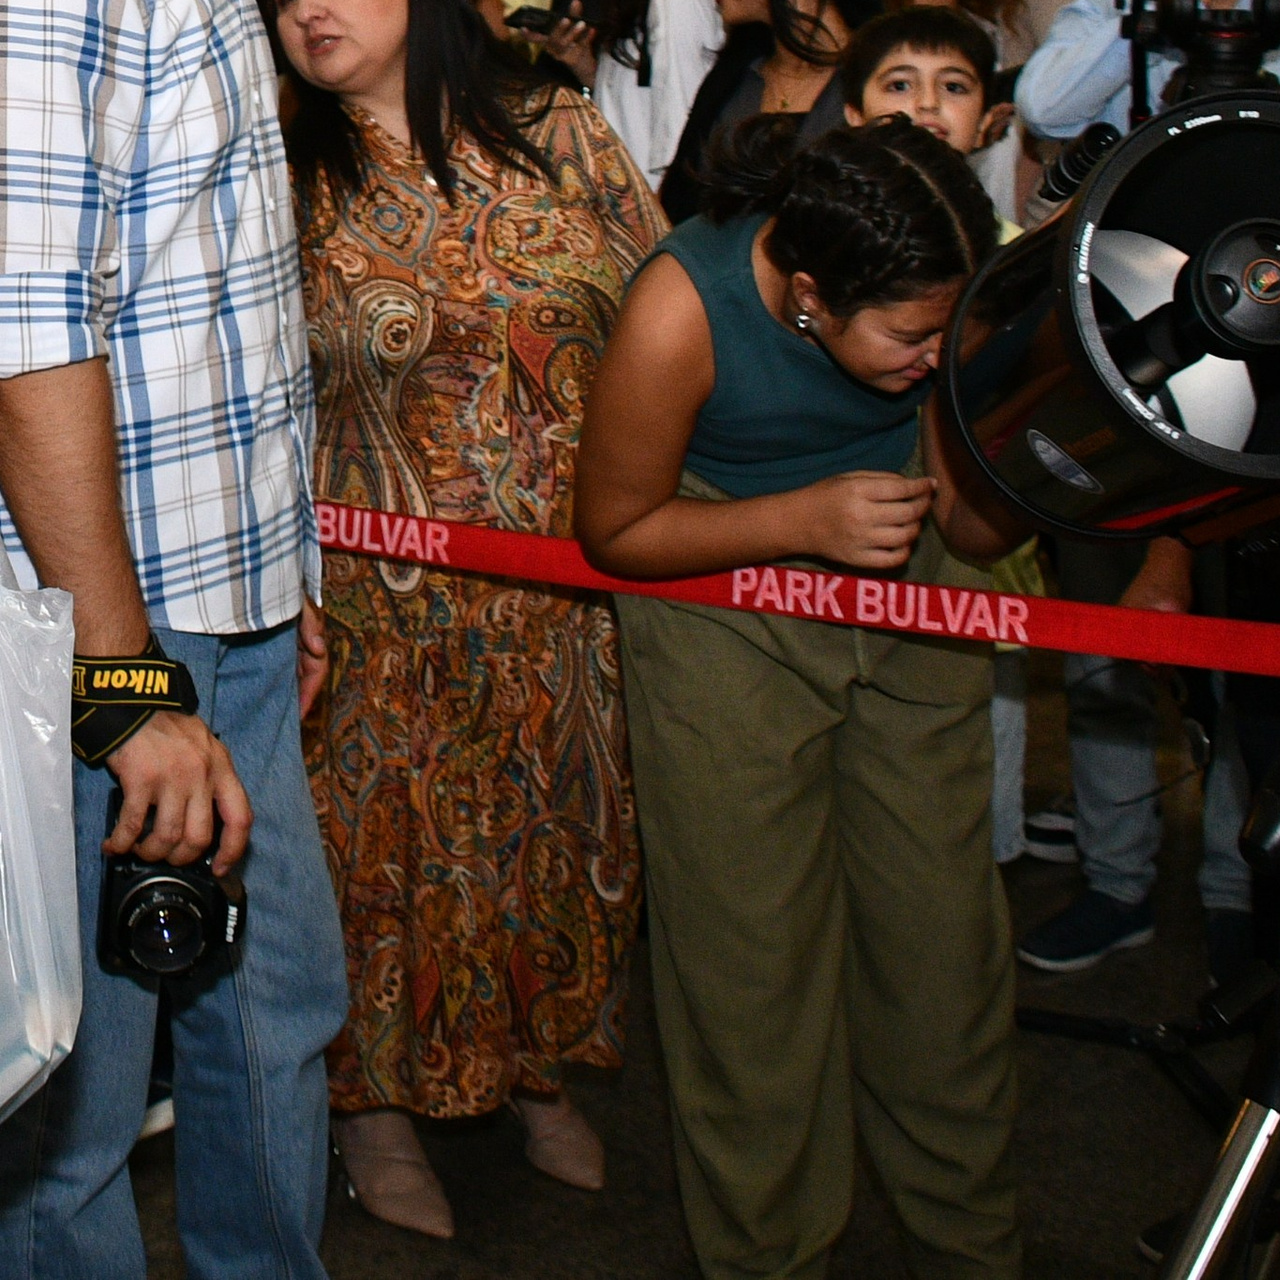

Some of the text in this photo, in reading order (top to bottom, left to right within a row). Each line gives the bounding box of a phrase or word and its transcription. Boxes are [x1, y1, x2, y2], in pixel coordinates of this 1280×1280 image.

[316, 503, 451, 564] BULVAR
[731, 566, 1030, 643] PARK BULVAR
[92, 669, 170, 695] Nikon
[224, 904, 239, 943] Nikon
